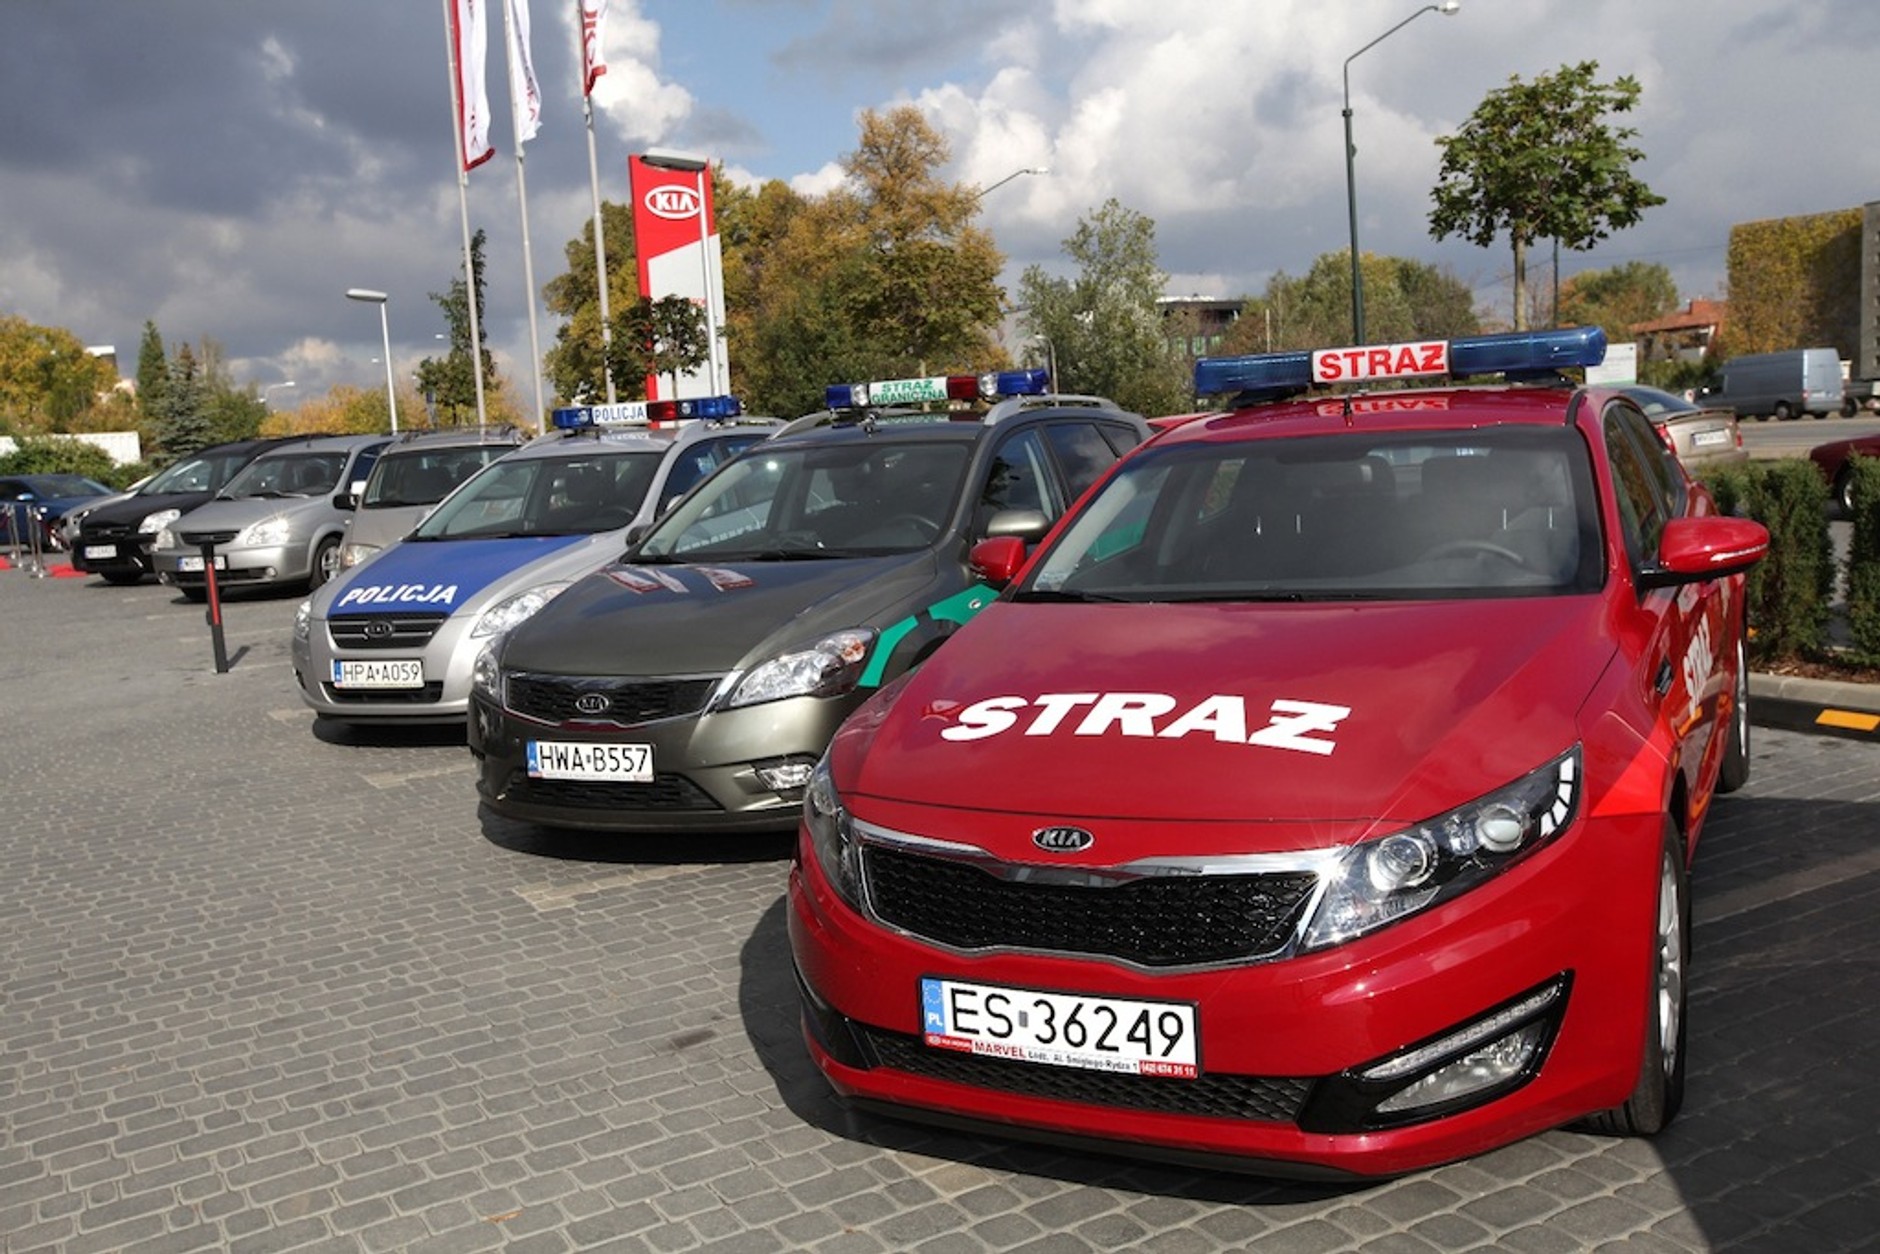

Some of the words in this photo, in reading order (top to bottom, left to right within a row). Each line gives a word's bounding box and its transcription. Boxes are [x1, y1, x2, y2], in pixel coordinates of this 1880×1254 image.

[655, 192, 695, 211] KIA
[871, 389, 946, 404] GRANICZNA
[594, 405, 646, 422] POLICJA
[338, 584, 458, 607] POLICJA
[1041, 829, 1082, 846] KIA
[928, 1011, 943, 1027] PL
[950, 987, 1014, 1040] ES
[1032, 998, 1185, 1058] 36249
[974, 1041, 1027, 1058] MARVEL
